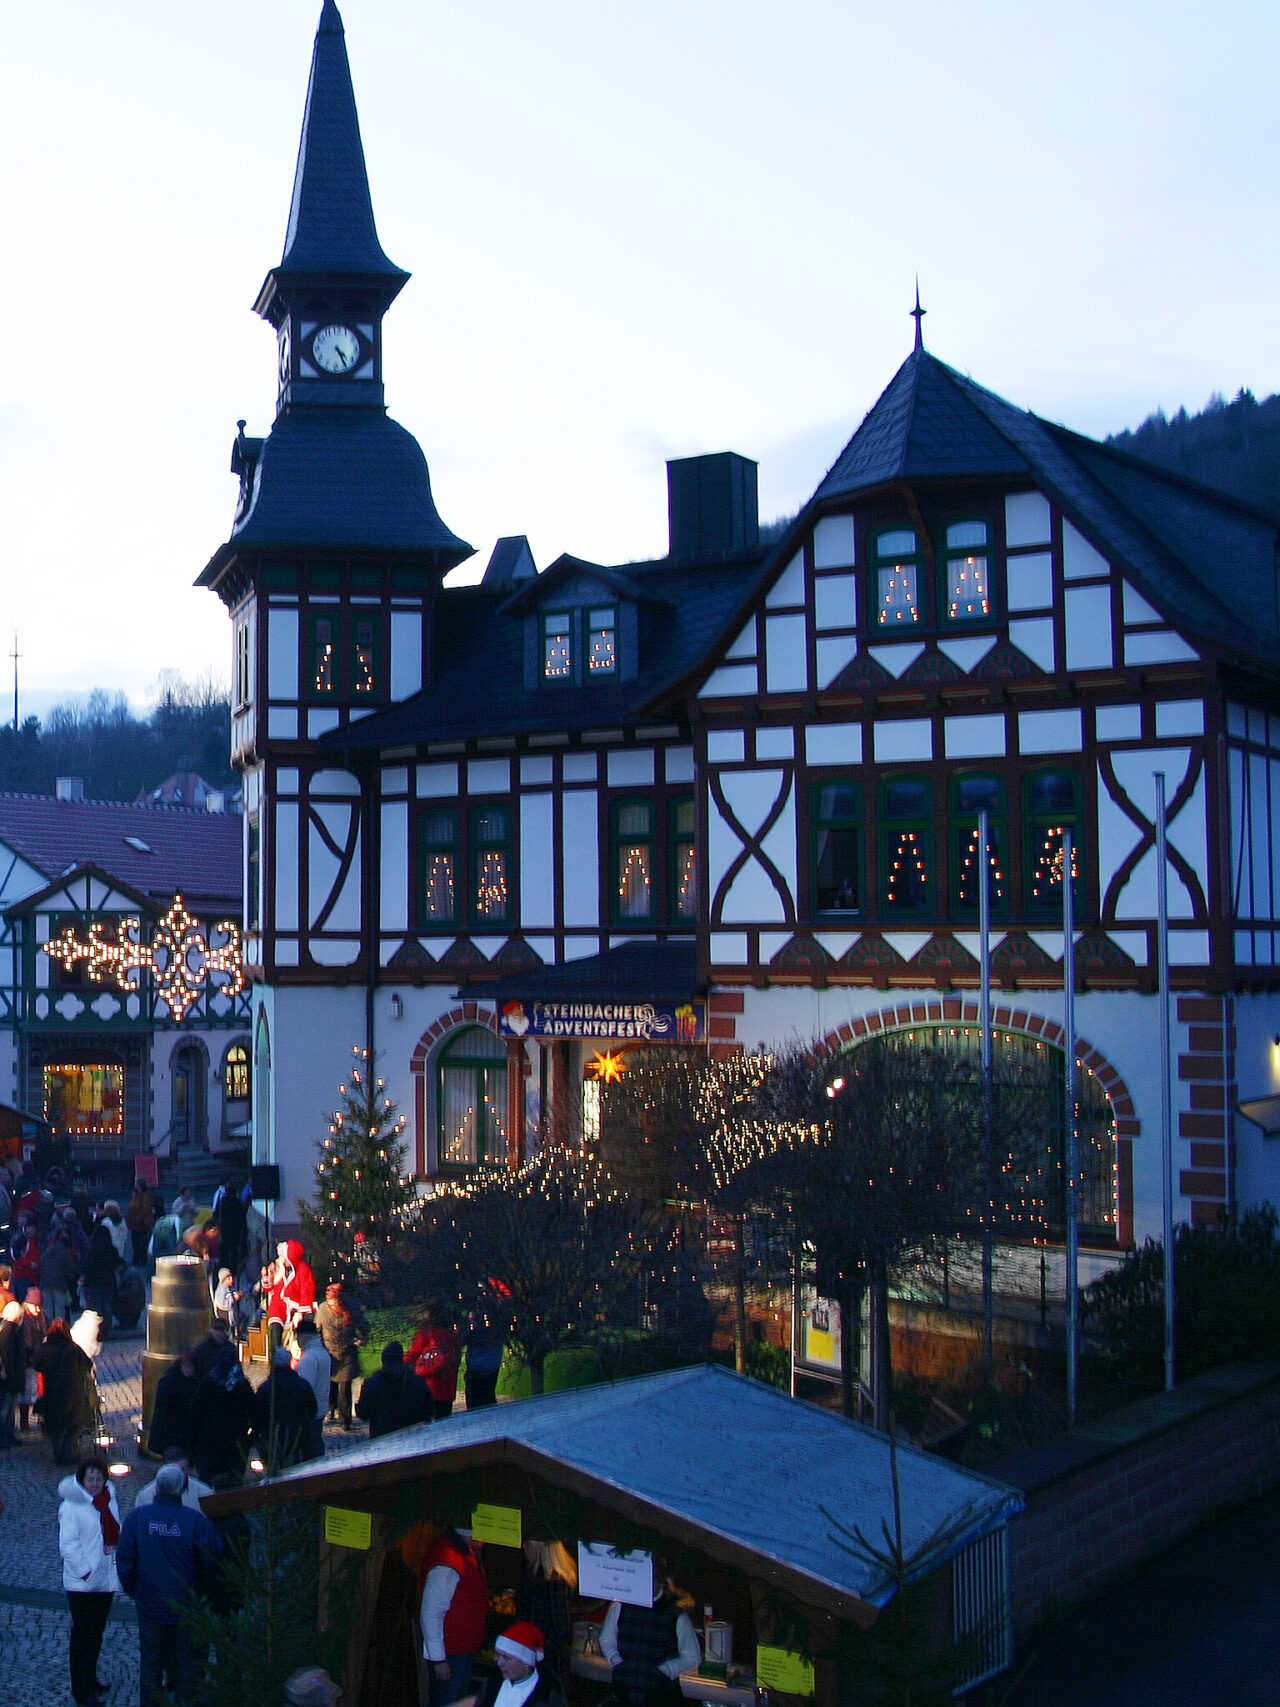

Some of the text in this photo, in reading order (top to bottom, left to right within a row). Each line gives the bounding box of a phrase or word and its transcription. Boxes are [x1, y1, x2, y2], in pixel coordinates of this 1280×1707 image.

[543, 1003, 644, 1021] STEINBACHER
[543, 1019, 642, 1037] ADVENTSFEST
[148, 1520, 181, 1537] FILA
